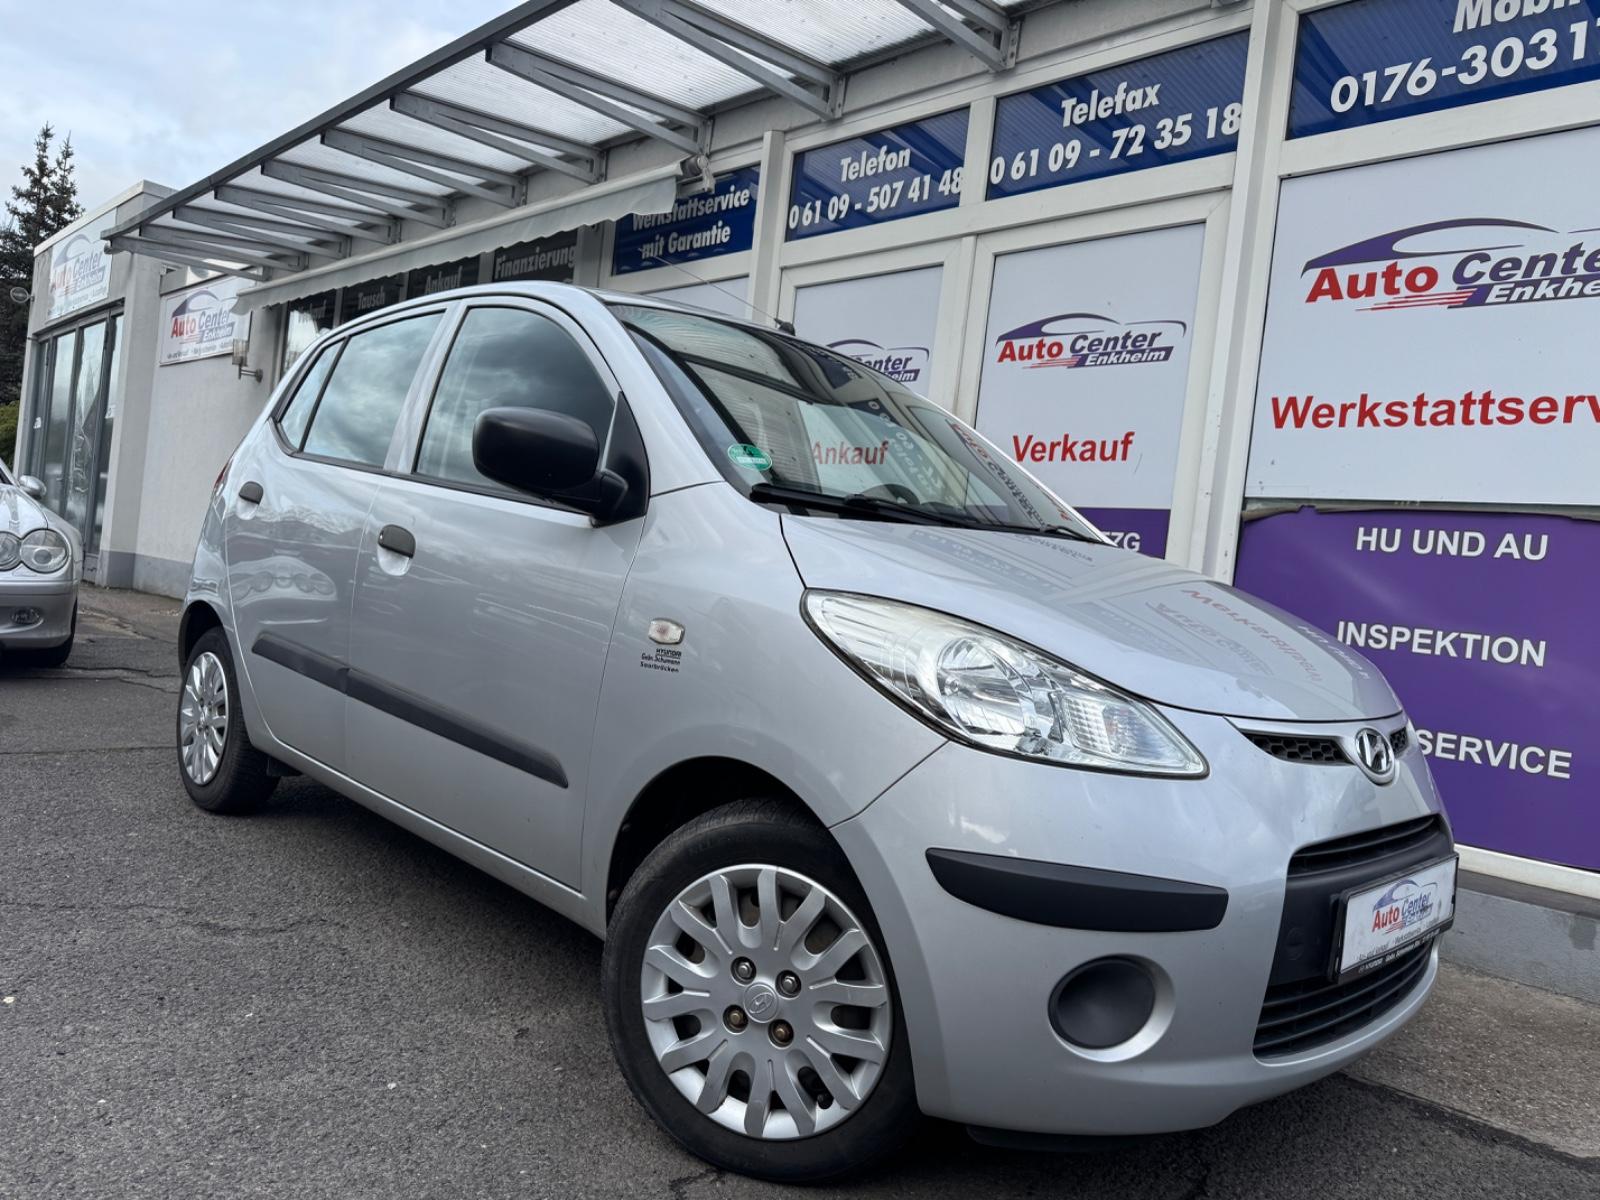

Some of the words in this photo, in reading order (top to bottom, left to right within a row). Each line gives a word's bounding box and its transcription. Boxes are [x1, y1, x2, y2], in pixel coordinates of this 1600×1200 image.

[1330, 17, 1600, 113] 0176-3031
[1061, 81, 1161, 128] Telefax
[990, 156, 1005, 185] 0
[1010, 148, 1039, 181] 61
[1048, 139, 1081, 172] 09
[1108, 123, 1146, 160] 72
[1153, 112, 1193, 150] 35
[1206, 102, 1242, 139] 18
[840, 145, 911, 183] Telefon
[788, 205, 799, 229] 0
[802, 200, 822, 226] 61
[827, 193, 850, 221] 09
[866, 180, 904, 213] 507
[908, 174, 931, 203] 41
[938, 166, 963, 196] 48
[641, 234, 665, 259] mit
[667, 220, 731, 254] Garantie
[425, 265, 463, 294] Ankauf
[494, 245, 577, 279] Finanzierung
[358, 285, 385, 310] Tausch
[1305, 261, 1439, 303] Auto
[171, 316, 197, 338] Auto
[198, 307, 230, 330] Center
[998, 338, 1063, 363] Auto
[1069, 330, 1162, 354] Center
[1084, 349, 1165, 366] Enkheim
[813, 440, 889, 465] Ankauf
[1013, 431, 1135, 463] Verkauf
[1356, 527, 1402, 552] HU
[1412, 529, 1486, 557] UND
[1493, 533, 1549, 561] AU
[1337, 620, 1546, 668] INSPEKTION
[1415, 729, 1572, 779] SERVICE
[1372, 905, 1399, 932] Auto
[1401, 890, 1432, 915] Center
